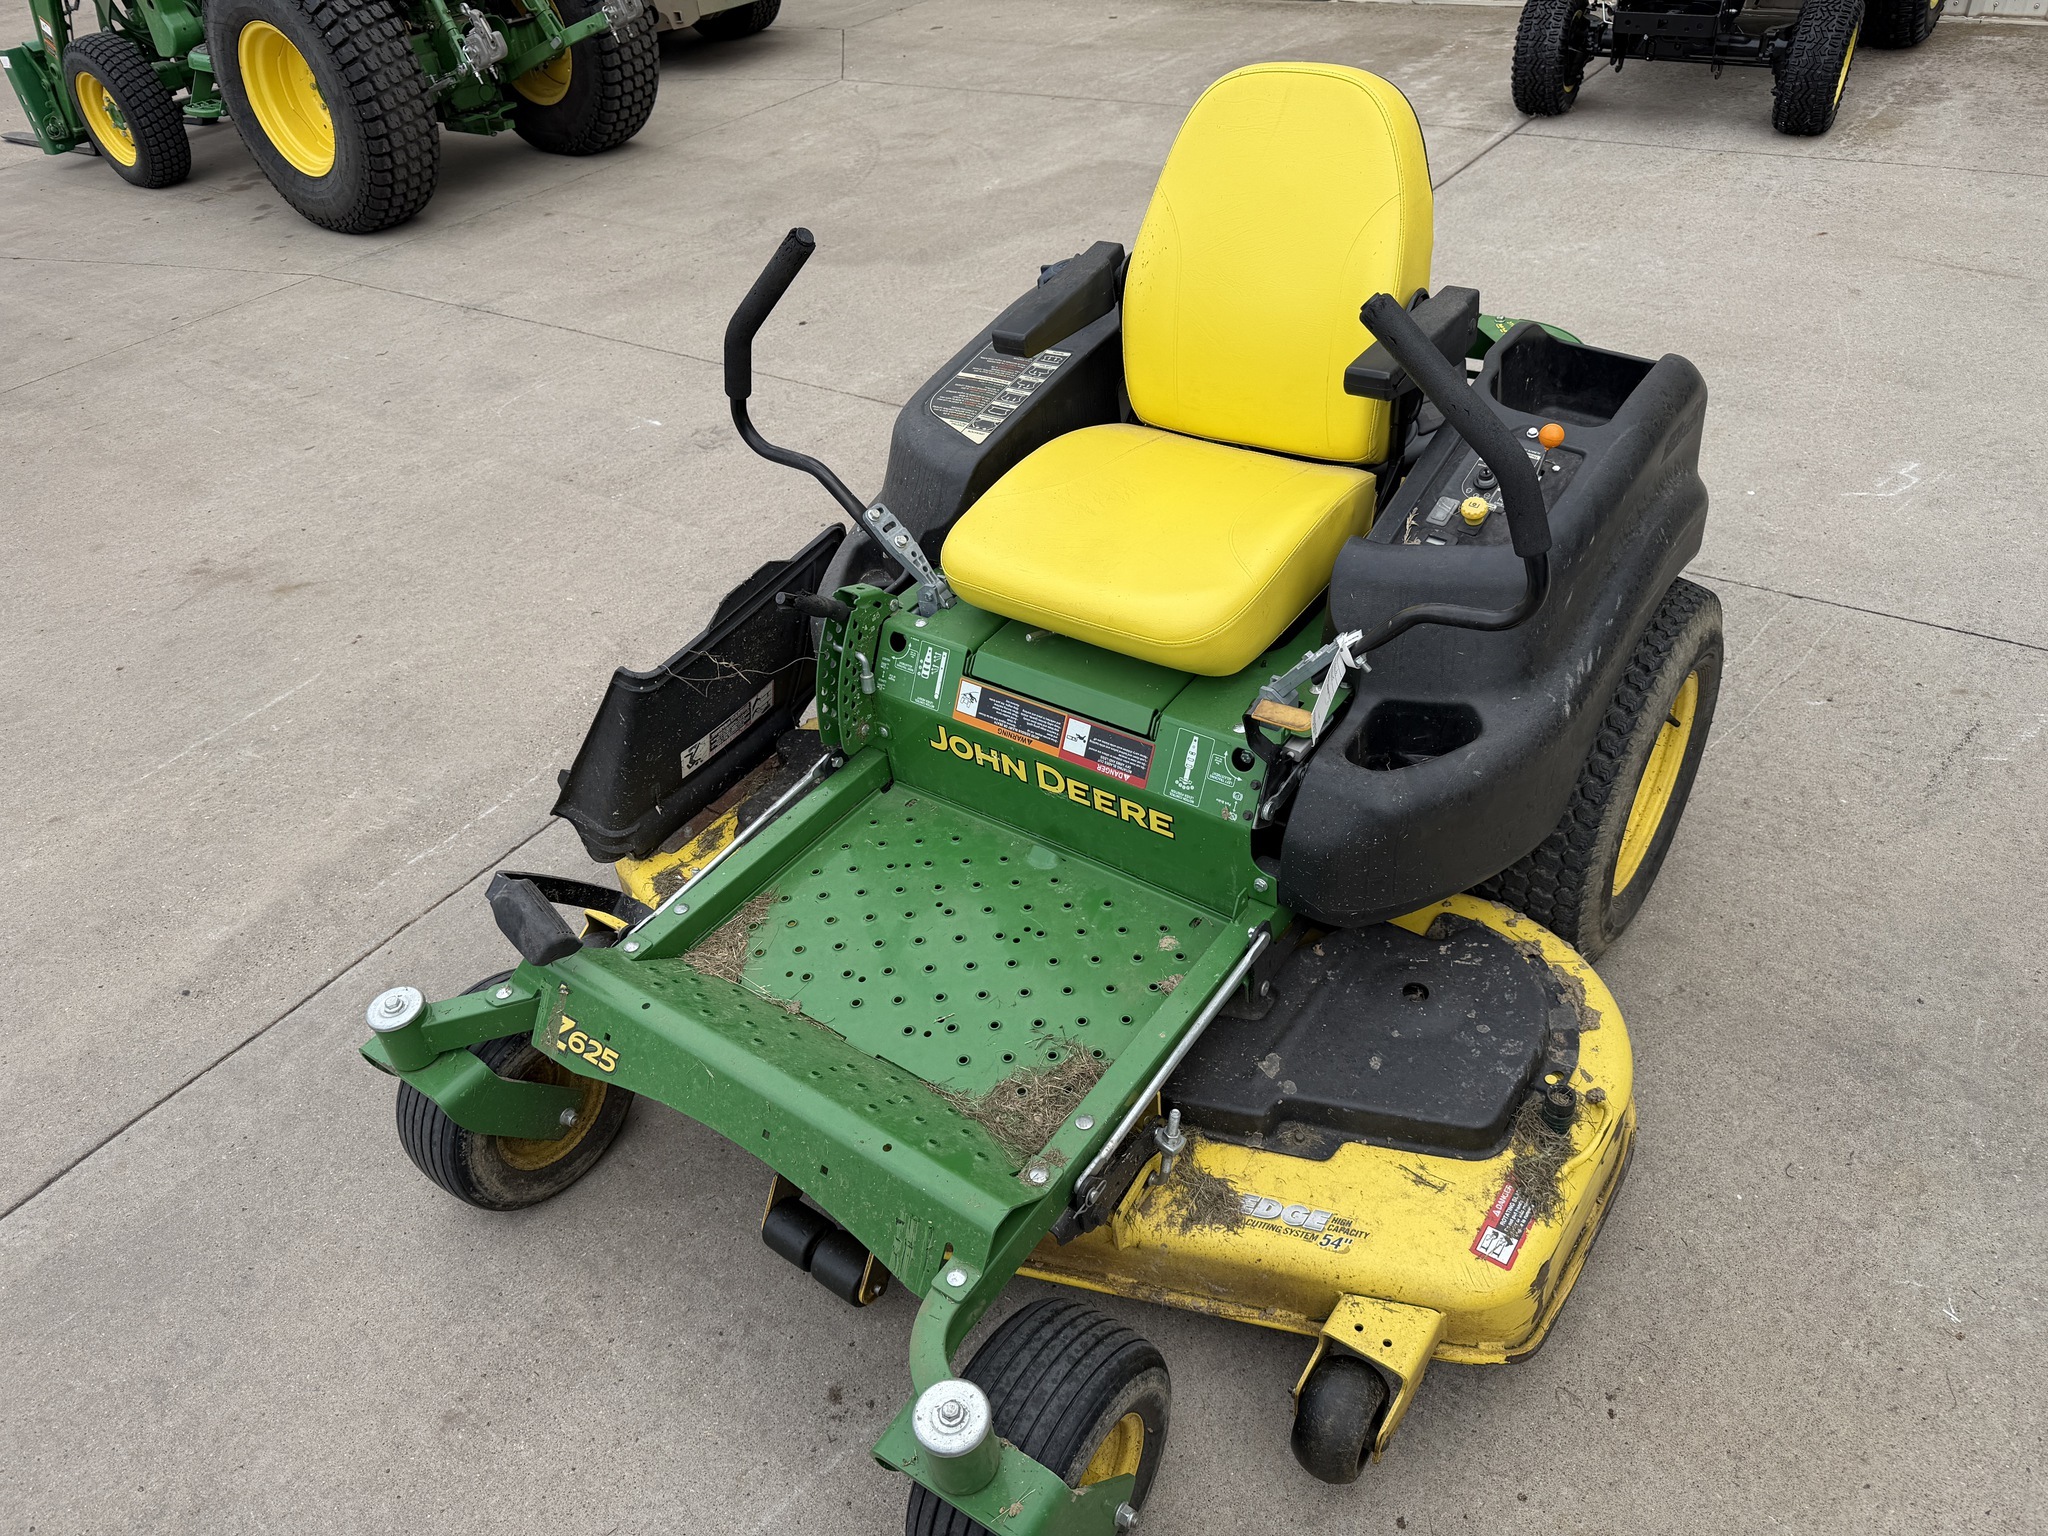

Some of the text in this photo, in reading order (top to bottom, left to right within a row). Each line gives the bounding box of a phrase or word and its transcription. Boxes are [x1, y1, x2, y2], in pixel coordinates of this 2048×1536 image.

[996, 727, 1028, 744] WARNING
[1095, 763, 1124, 779] DANGER
[929, 724, 1028, 784] JOHN
[1035, 761, 1175, 839] DEERE
[1495, 1184, 1514, 1211] DANGER
[1241, 1193, 1333, 1232] EDGE
[1245, 1218, 1320, 1242] CUTTING SYSTEM
[1331, 1216, 1353, 1228] HIGH
[1326, 1224, 1371, 1240] CAPACITY
[1318, 1233, 1354, 1250] 54"
